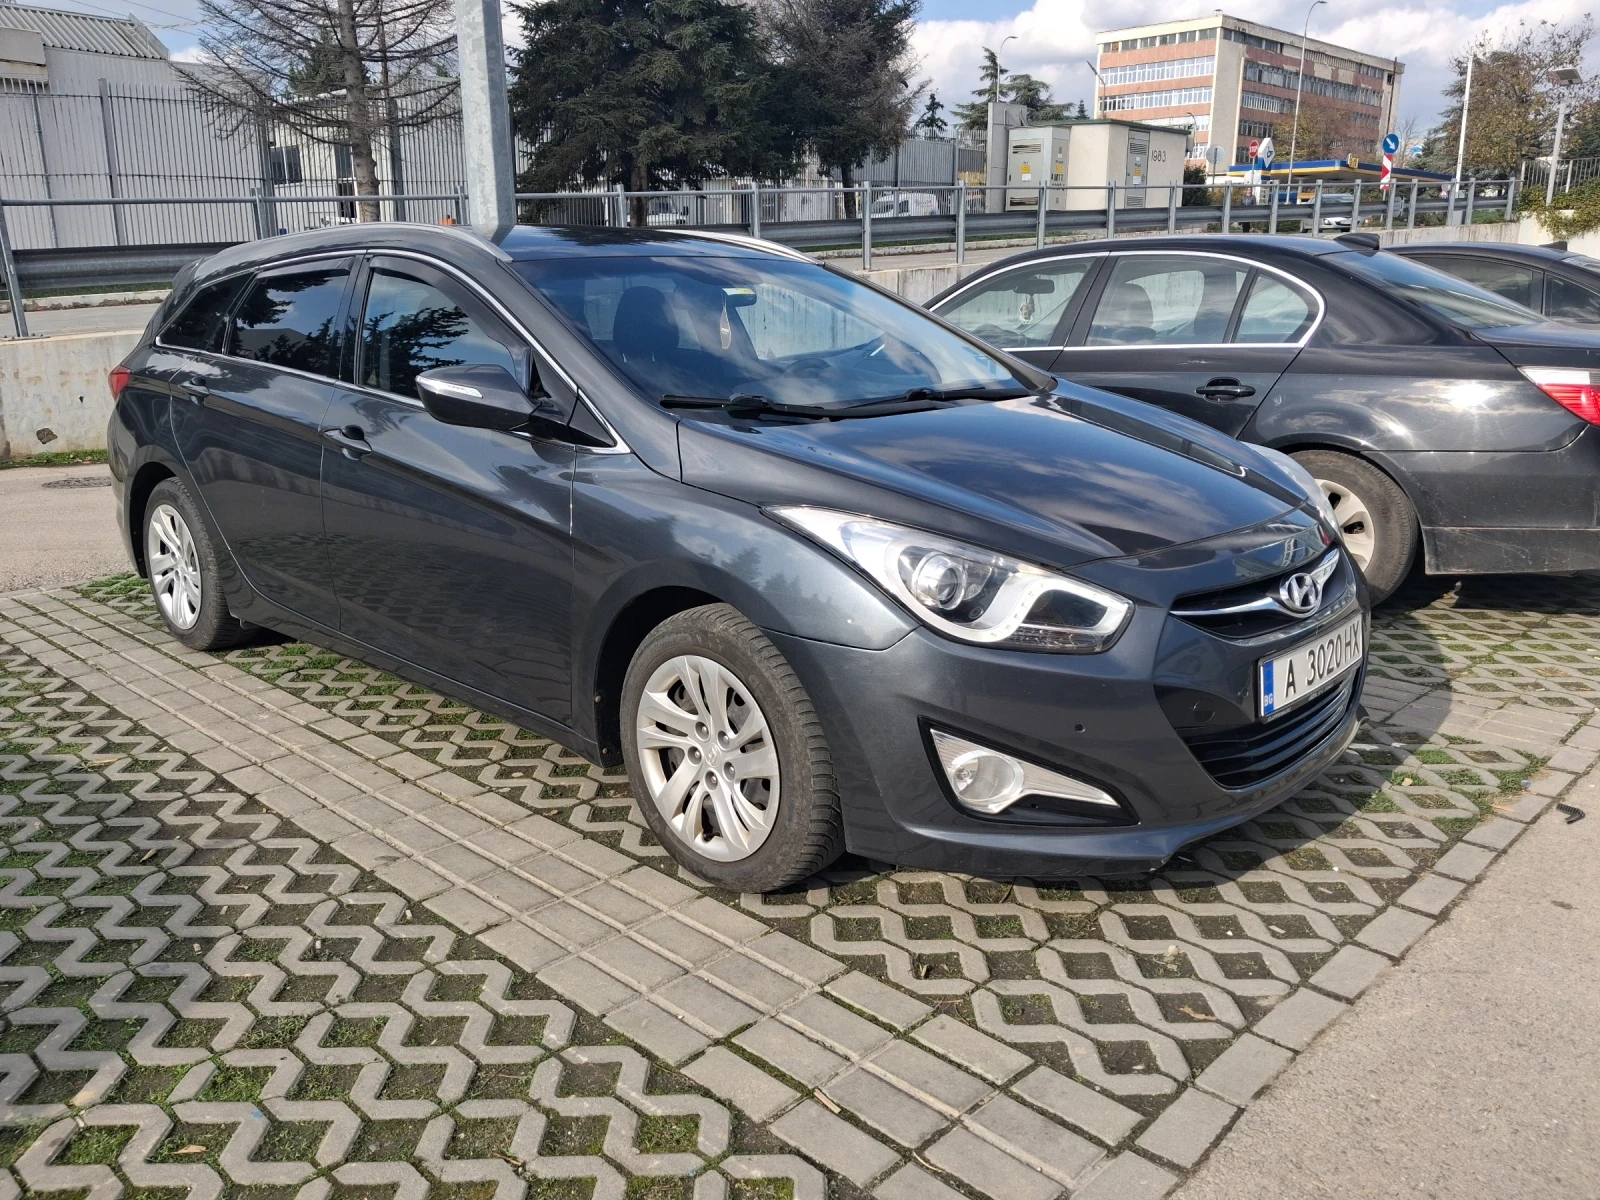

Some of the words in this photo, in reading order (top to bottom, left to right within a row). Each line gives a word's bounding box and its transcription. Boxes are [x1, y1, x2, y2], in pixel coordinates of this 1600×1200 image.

[1285, 659, 1297, 699] A
[1306, 634, 1342, 686] 3020
[1344, 620, 1360, 663] HX
[1264, 693, 1273, 706] BG
